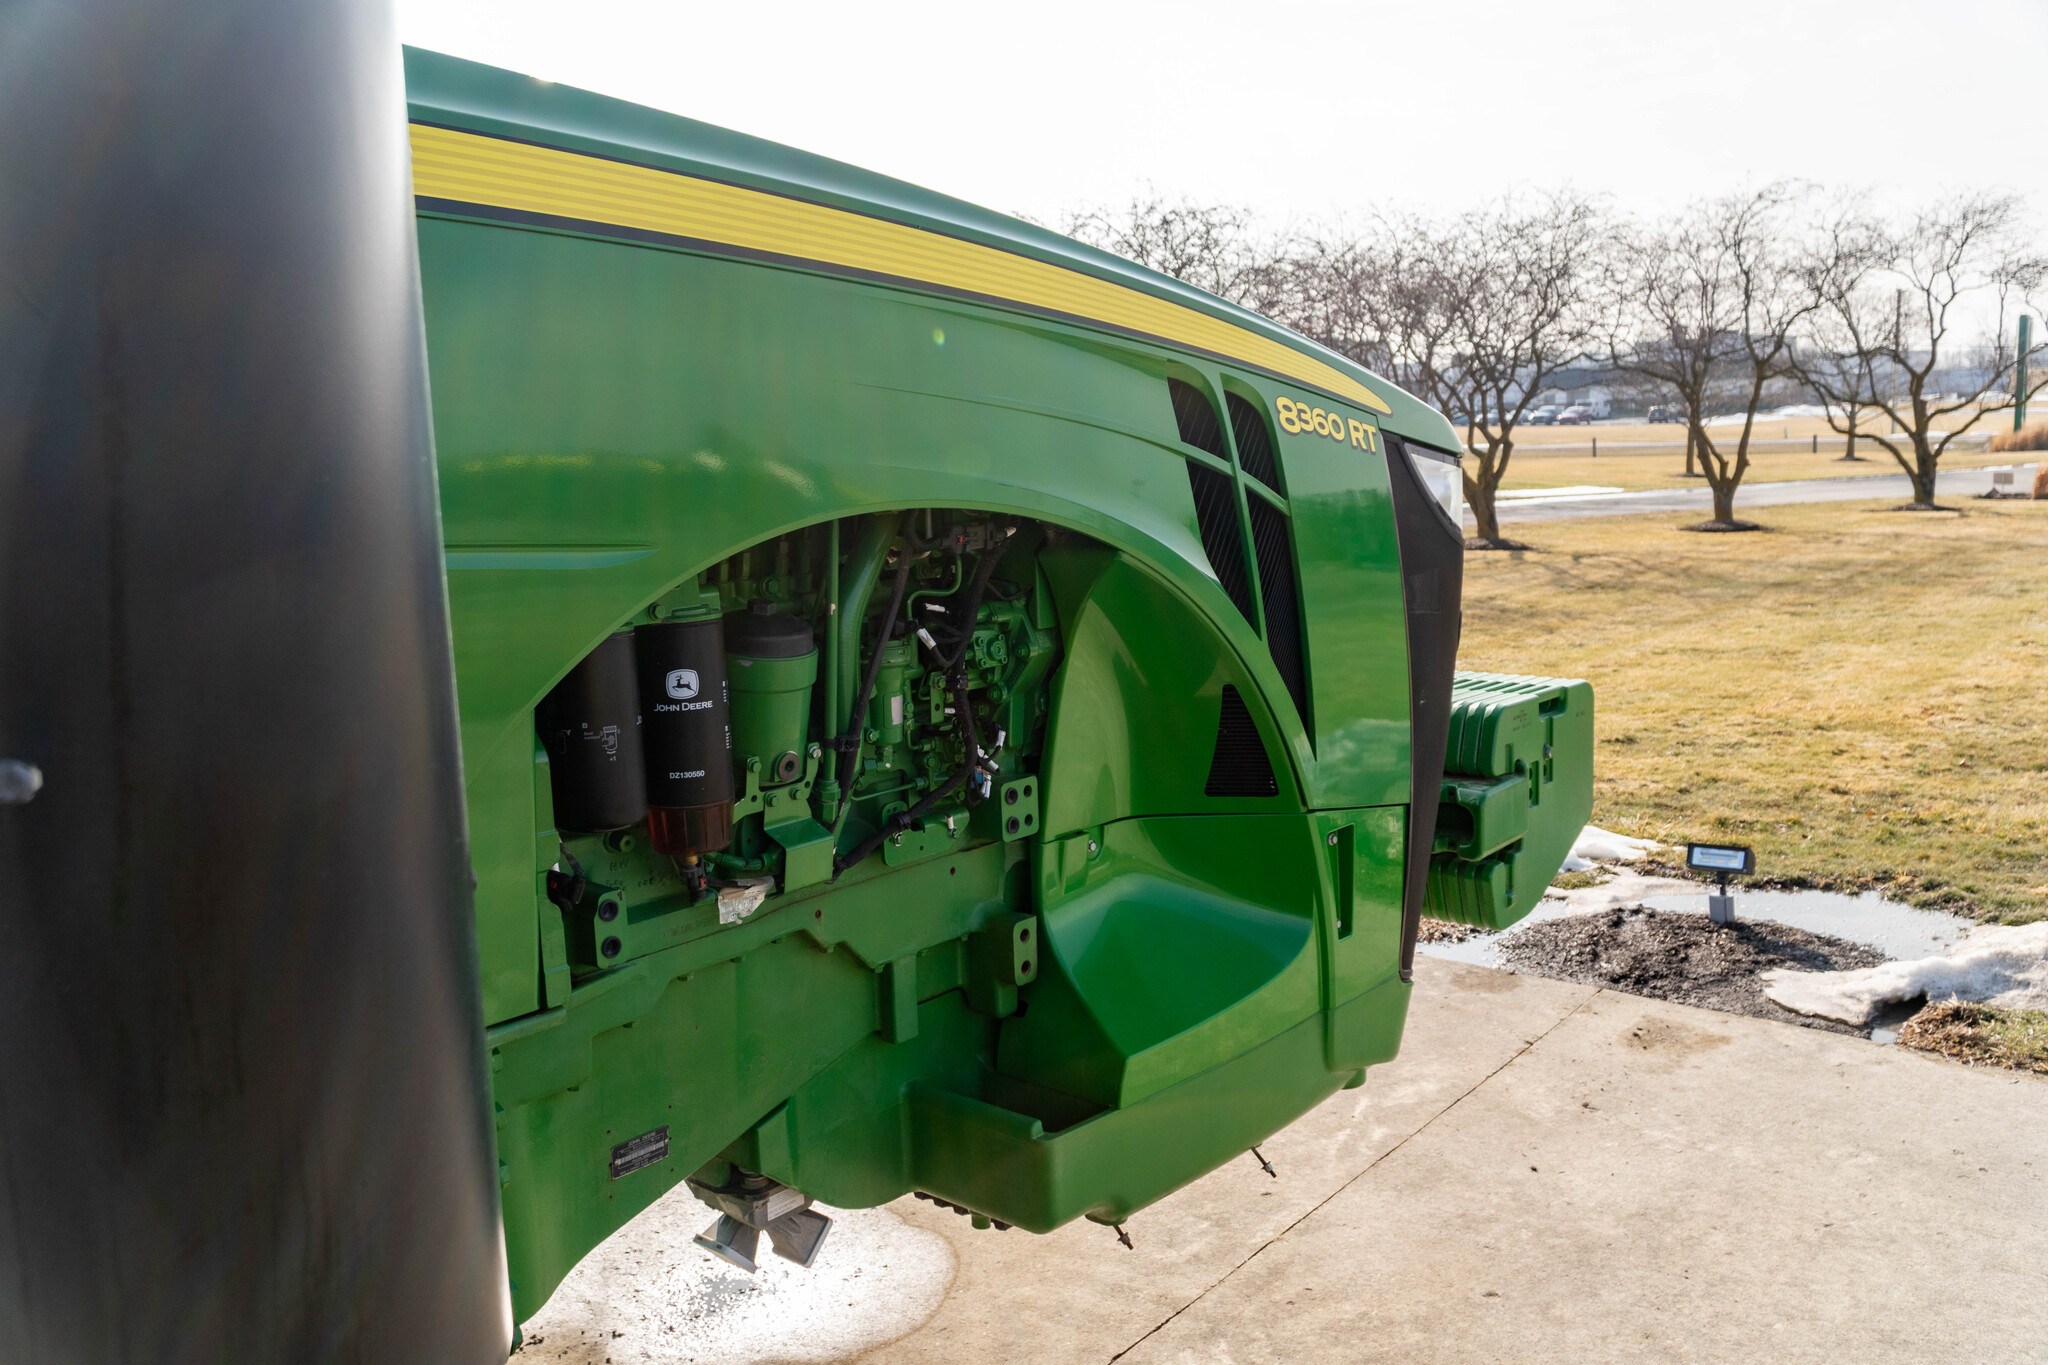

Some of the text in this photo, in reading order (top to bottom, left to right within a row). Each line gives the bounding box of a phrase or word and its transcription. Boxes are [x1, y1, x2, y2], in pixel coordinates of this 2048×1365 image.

[1275, 396, 1377, 454] 8360 RT
[653, 700, 713, 712] JOHN DEERE
[669, 770, 705, 779] DZ130550
